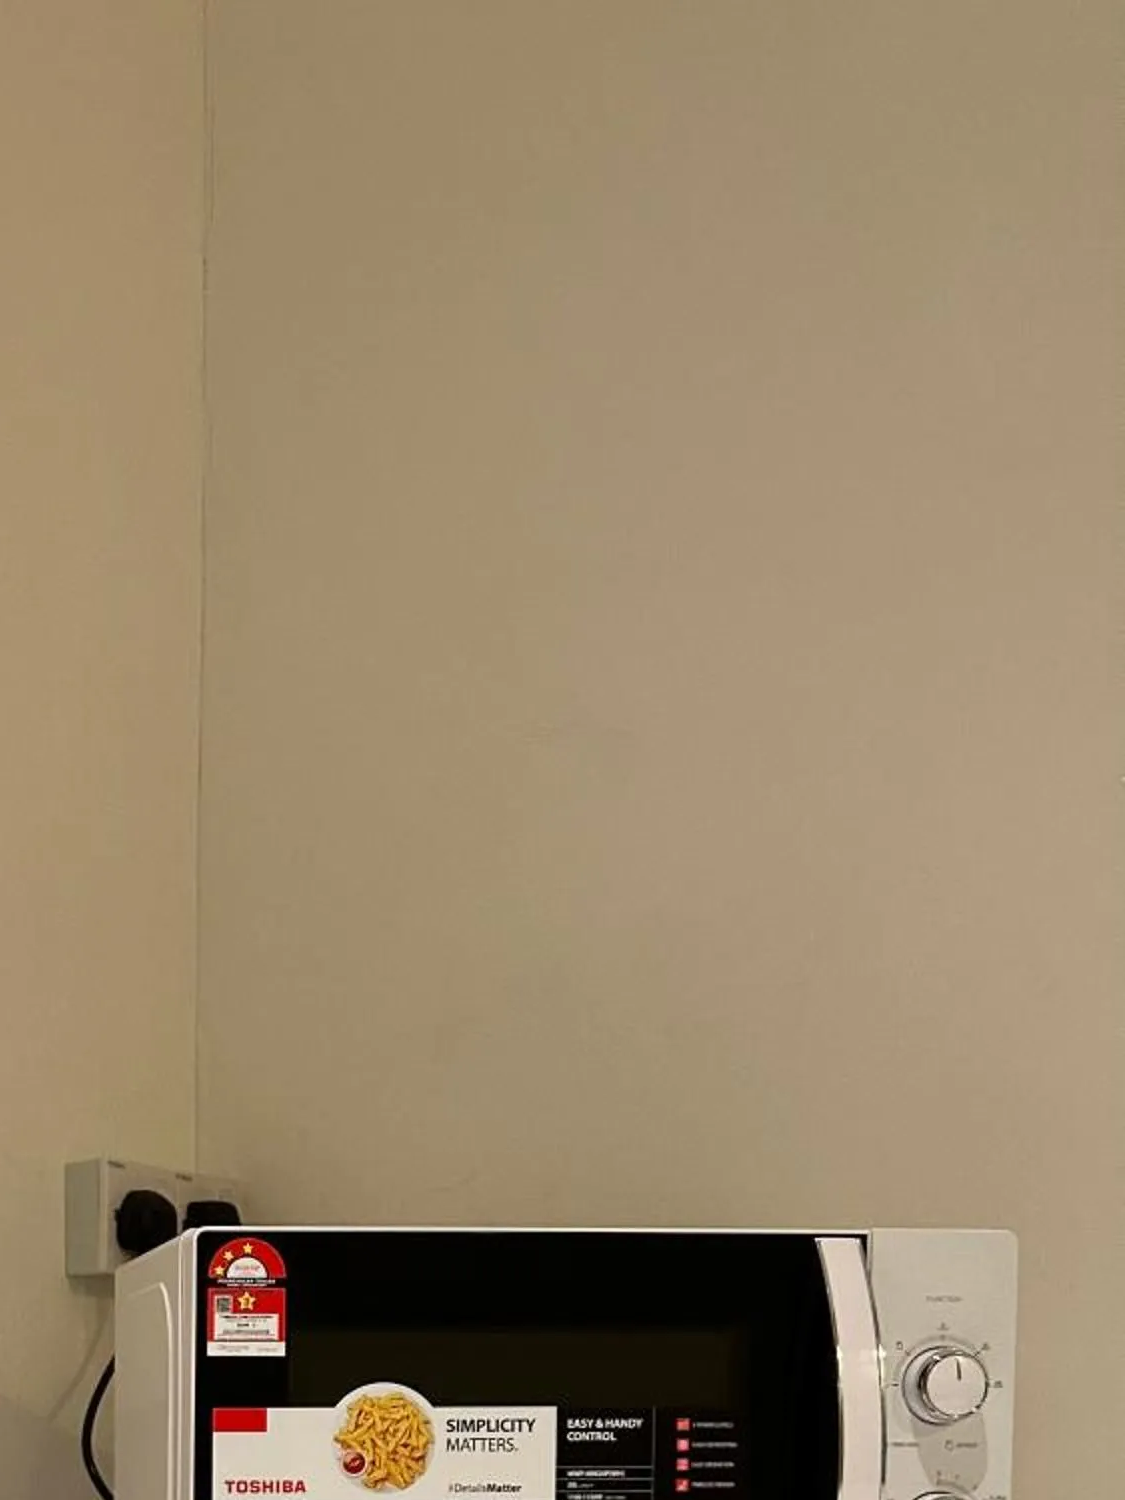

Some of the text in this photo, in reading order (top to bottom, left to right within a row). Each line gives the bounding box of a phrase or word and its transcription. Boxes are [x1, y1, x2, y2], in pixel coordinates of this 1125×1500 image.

[446, 1418, 536, 1433] SIMPLICITY
[567, 1418, 643, 1429] EASY & HANDY
[566, 1431, 617, 1441] CONTROL
[446, 1437, 519, 1452] MATTERS.
[224, 1479, 307, 1494] TOSHIBA
